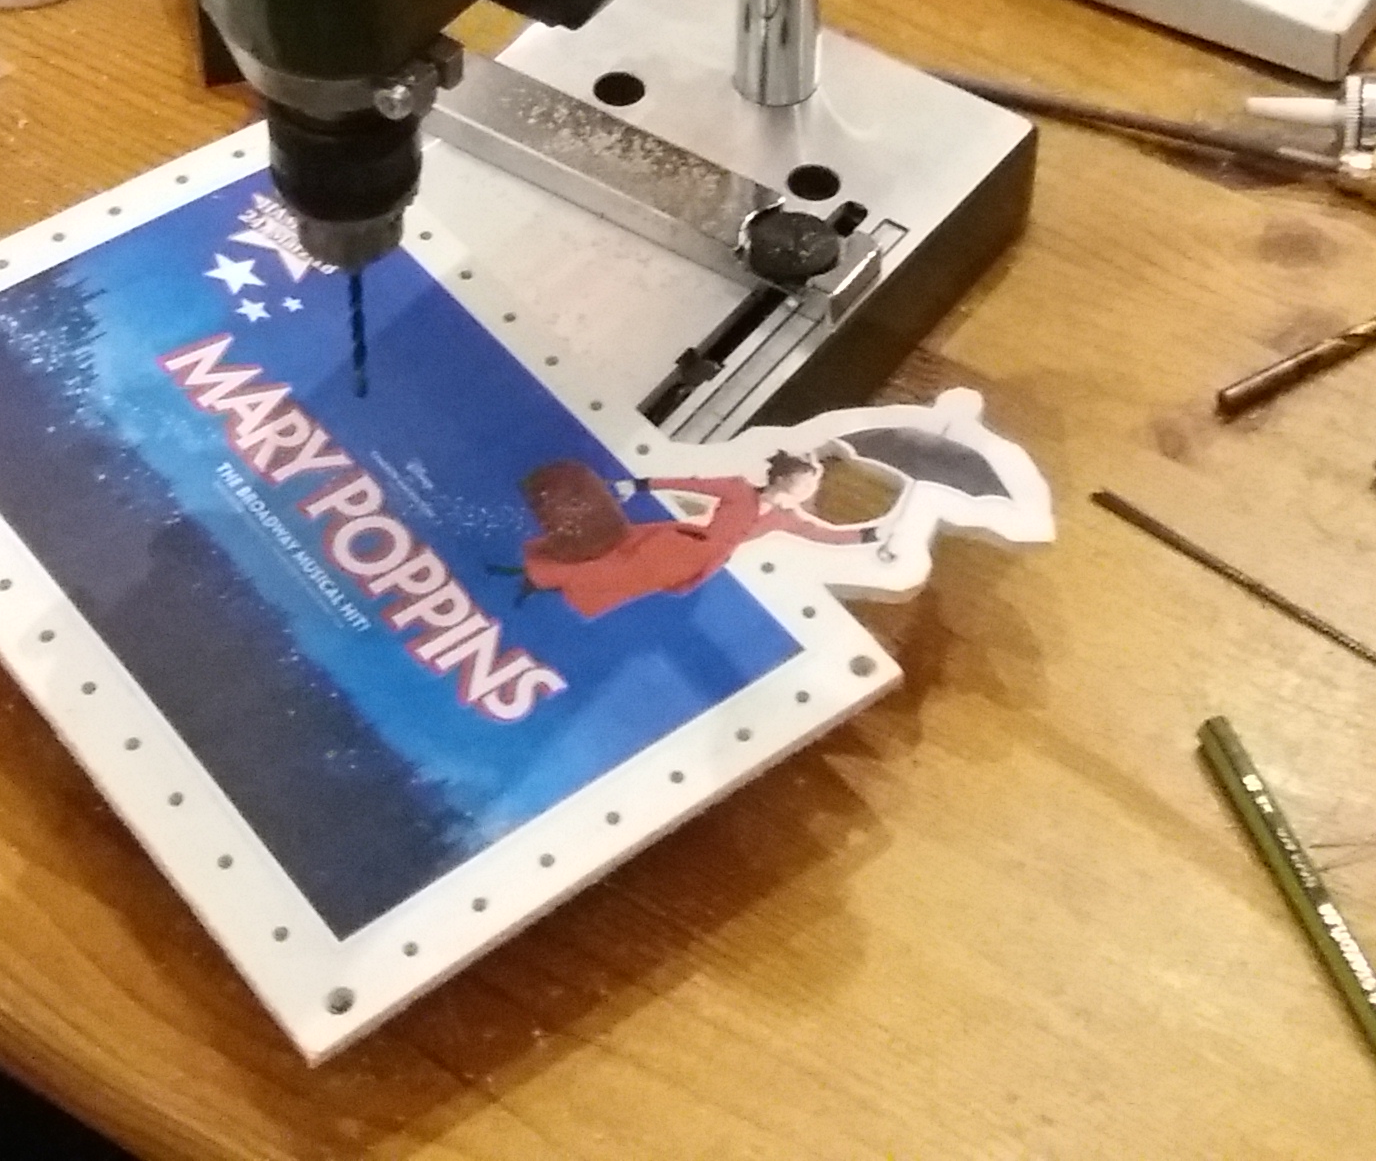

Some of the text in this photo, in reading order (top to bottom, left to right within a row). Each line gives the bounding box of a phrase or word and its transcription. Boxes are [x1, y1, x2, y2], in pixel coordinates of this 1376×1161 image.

[158, 333, 352, 485] MARY
[302, 469, 569, 722] POPPINS
[216, 462, 244, 488] THE
[236, 486, 302, 551] BROADWAY
[291, 550, 345, 606] MUSICAL
